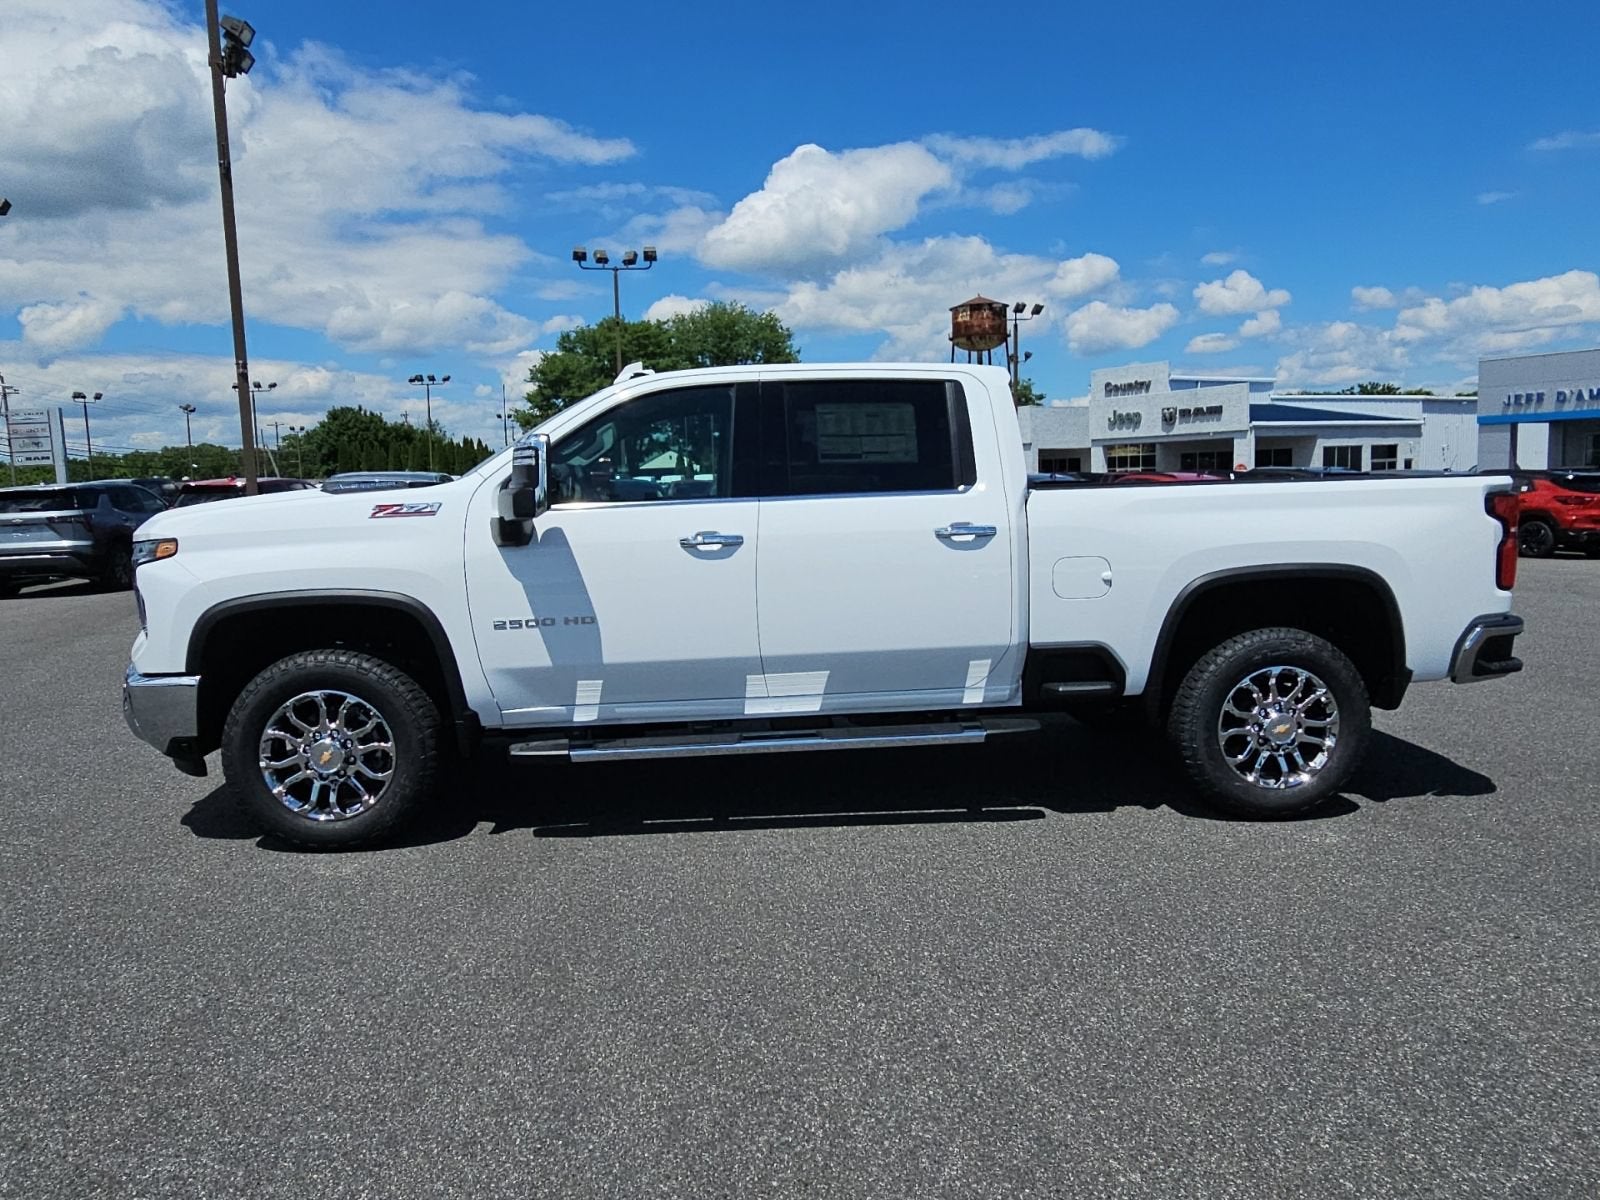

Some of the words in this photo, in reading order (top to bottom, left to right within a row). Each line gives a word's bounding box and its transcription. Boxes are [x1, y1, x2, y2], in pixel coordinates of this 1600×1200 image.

[1104, 380, 1152, 395] Country
[1502, 391, 1545, 407] JEFF
[1107, 410, 1142, 429] Jeep
[1178, 405, 1223, 419] RAM
[368, 502, 443, 519] Z71
[493, 618, 556, 630] 2500
[563, 616, 597, 626] HD
